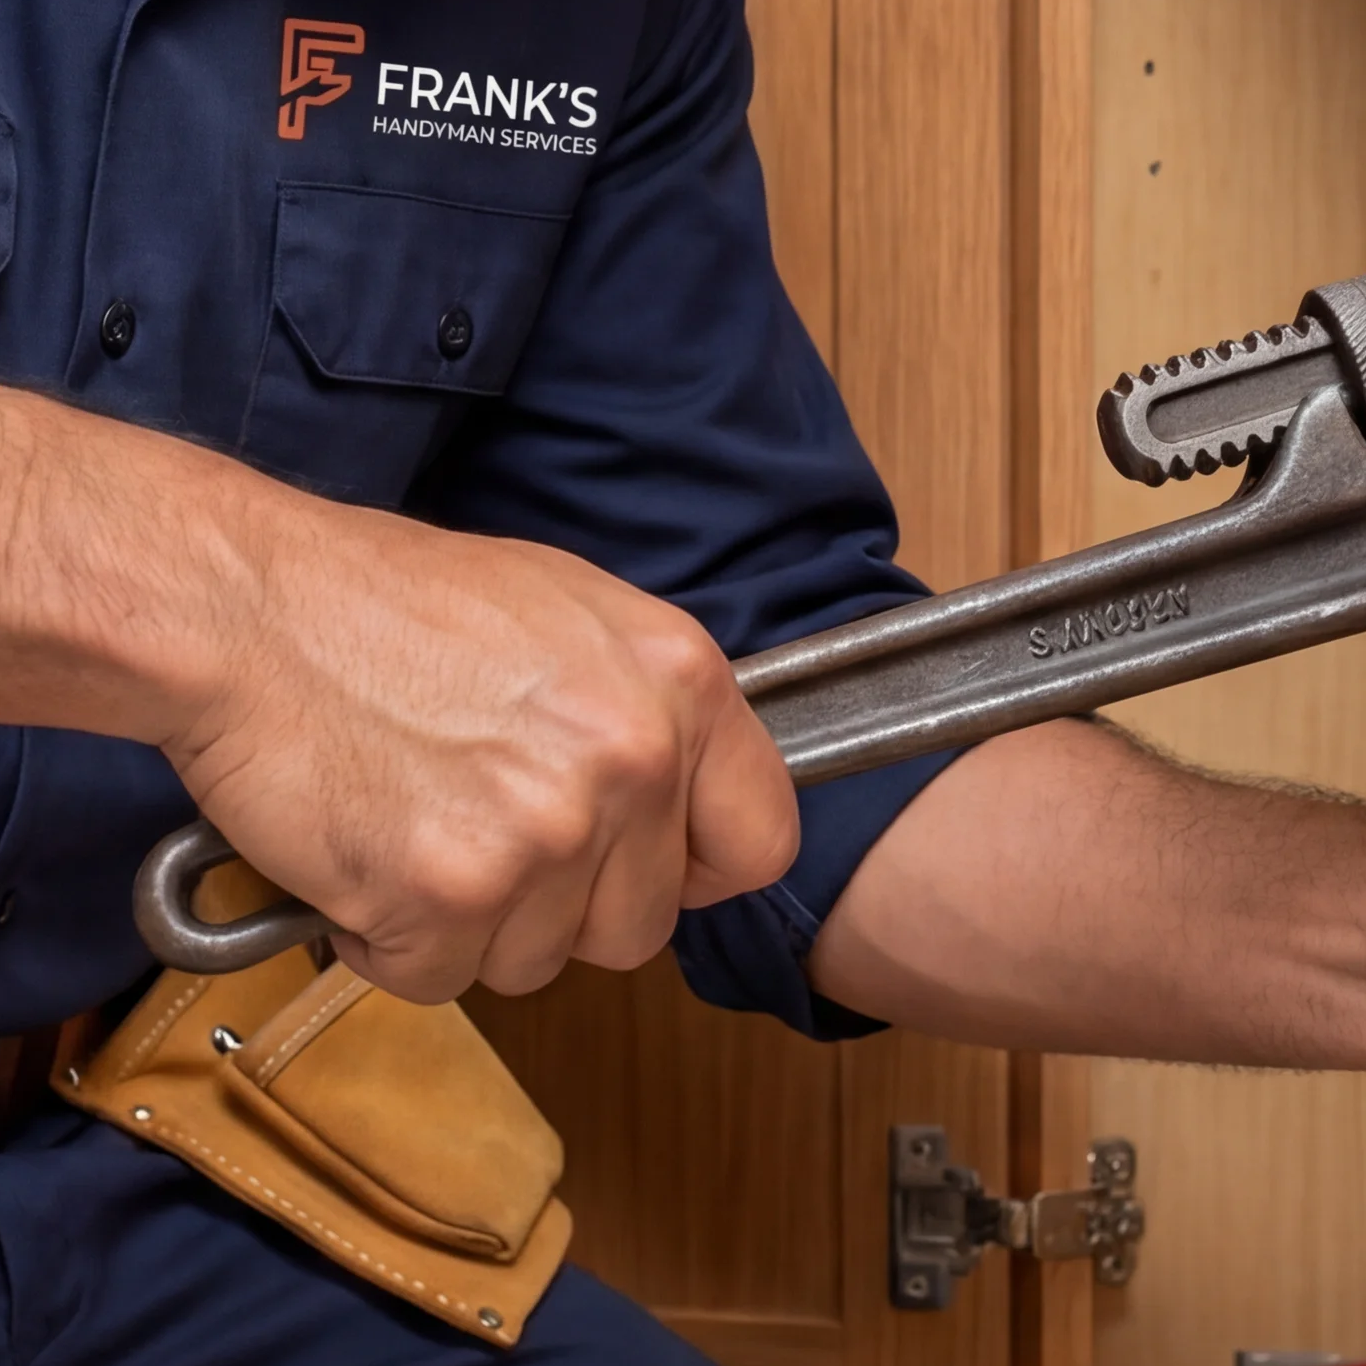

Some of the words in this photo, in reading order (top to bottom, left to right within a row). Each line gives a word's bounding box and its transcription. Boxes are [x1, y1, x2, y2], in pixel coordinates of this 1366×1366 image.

[377, 62, 598, 128] FRANK'S
[373, 116, 495, 145] HANDYMAN
[500, 129, 597, 155] SERVICES
